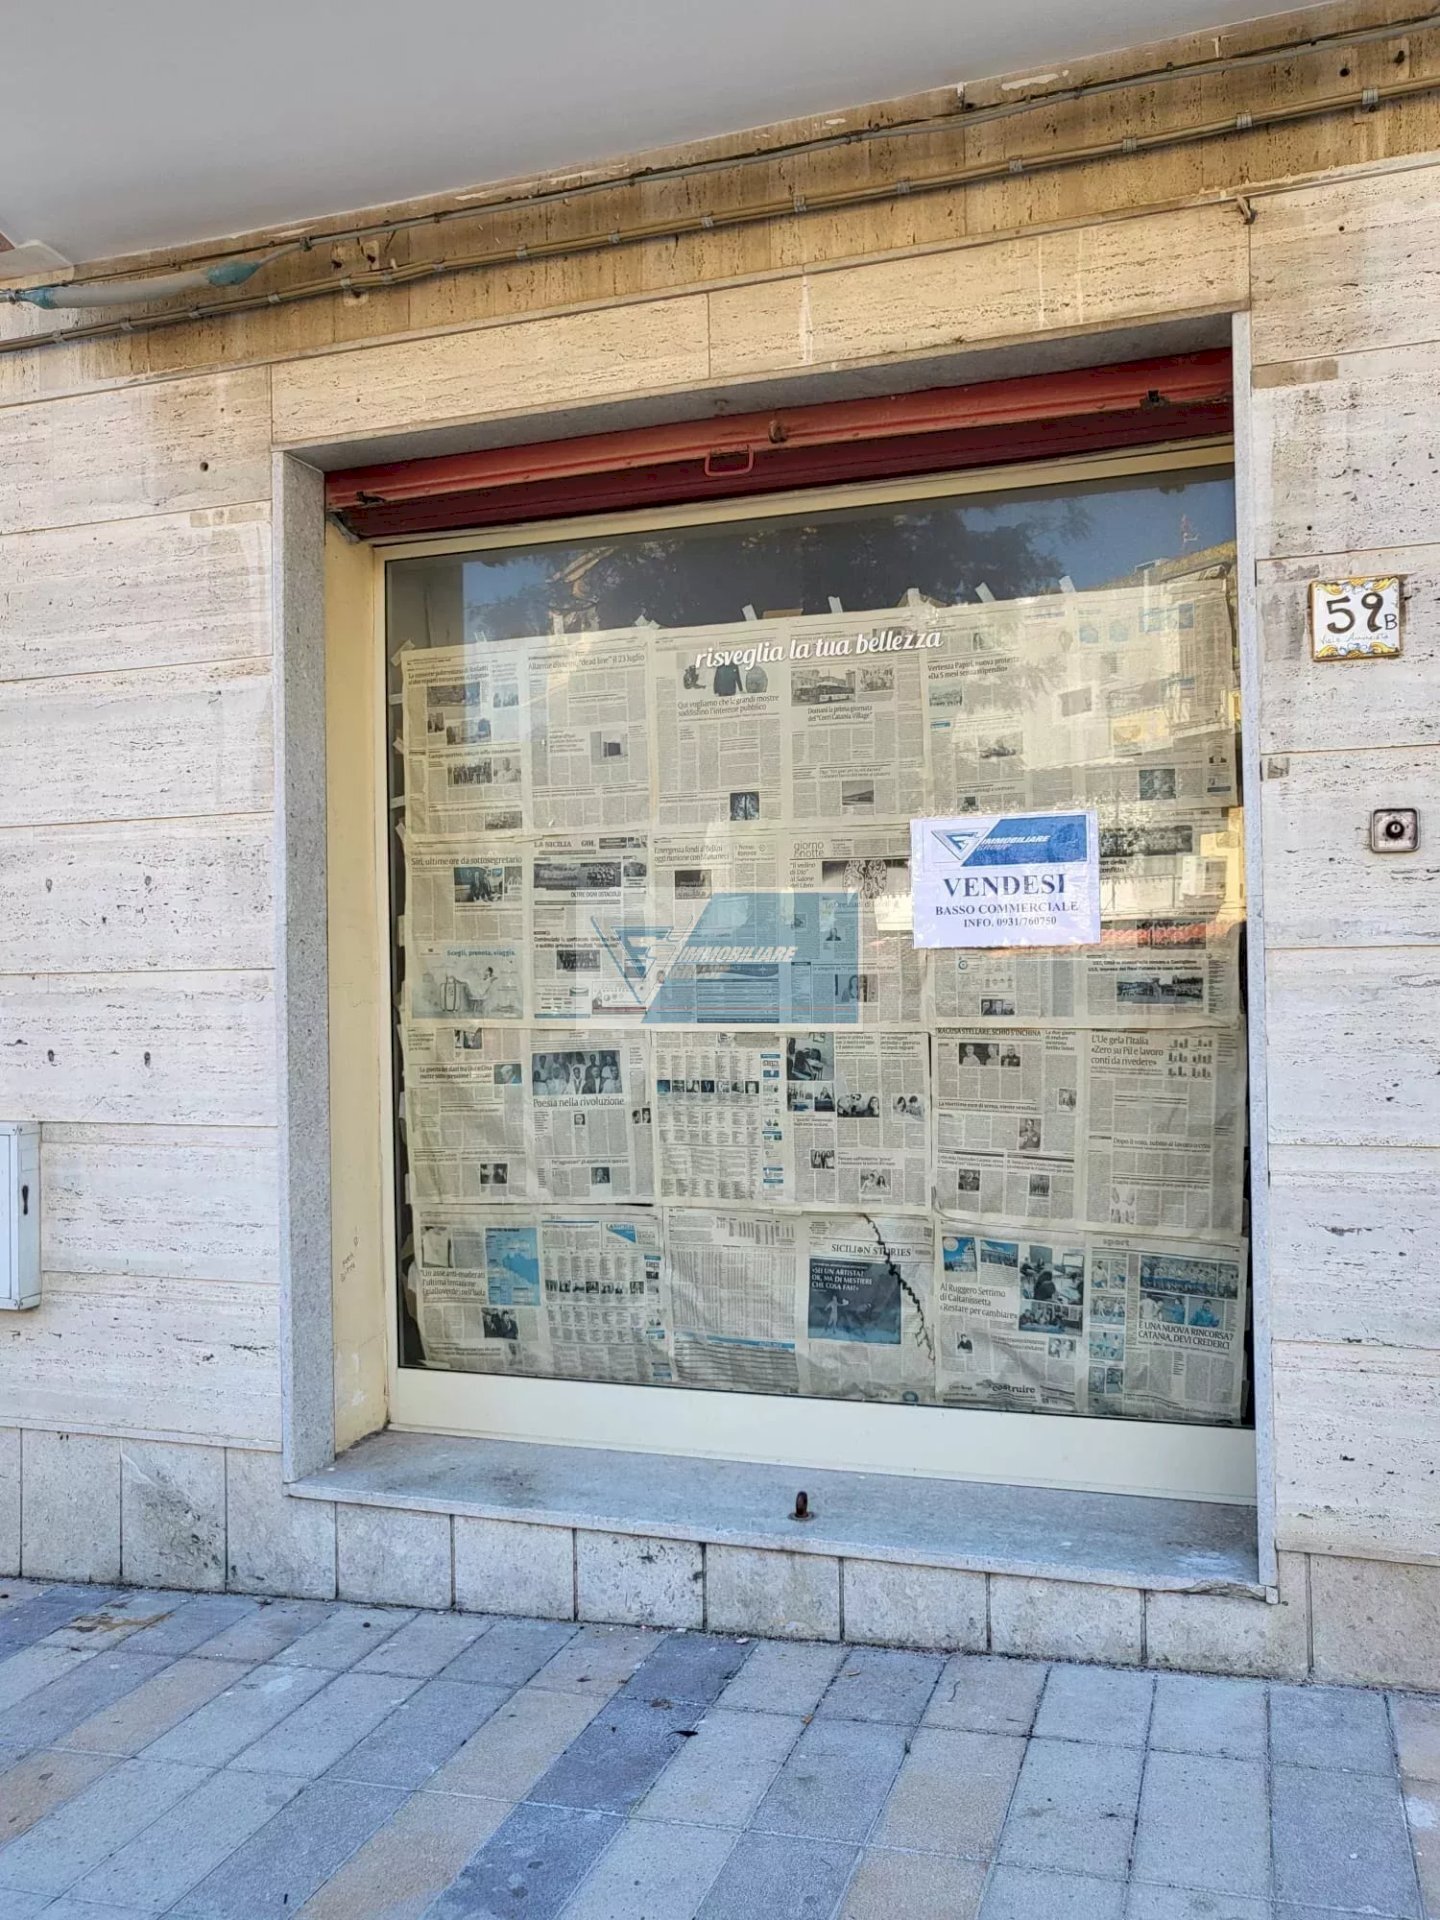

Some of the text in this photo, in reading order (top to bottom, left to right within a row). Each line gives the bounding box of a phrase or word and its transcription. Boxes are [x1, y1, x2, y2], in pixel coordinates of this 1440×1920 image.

[1326, 592, 1398, 634] 59 B
[695, 630, 943, 670] risveglia la tua bellezza
[794, 840, 824, 851] giorno
[943, 873, 1065, 897] VENDESI
[936, 901, 1079, 916] BASSO COMMERCIALE
[964, 916, 1057, 928] INFO. 0931/760750
[1108, 1035, 1125, 1046] gela
[1090, 1056, 1110, 1065] conti
[1111, 1056, 1120, 1065] da
[533, 1096, 625, 1107] Poesia nella rivoluzione
[948, 1284, 977, 1295] Ruggero
[978, 1287, 1006, 1298] Settimo
[948, 1294, 991, 1307] Caltanissetta
[1144, 1321, 1161, 1331] UNA
[1161, 1324, 1190, 1335] NUOVA
[1190, 1328, 1234, 1341] RINCORSA?
[1173, 1334, 1192, 1345] DEVI
[1192, 1336, 1230, 1350] CREDERCI
[992, 1382, 1036, 1394] costruire
